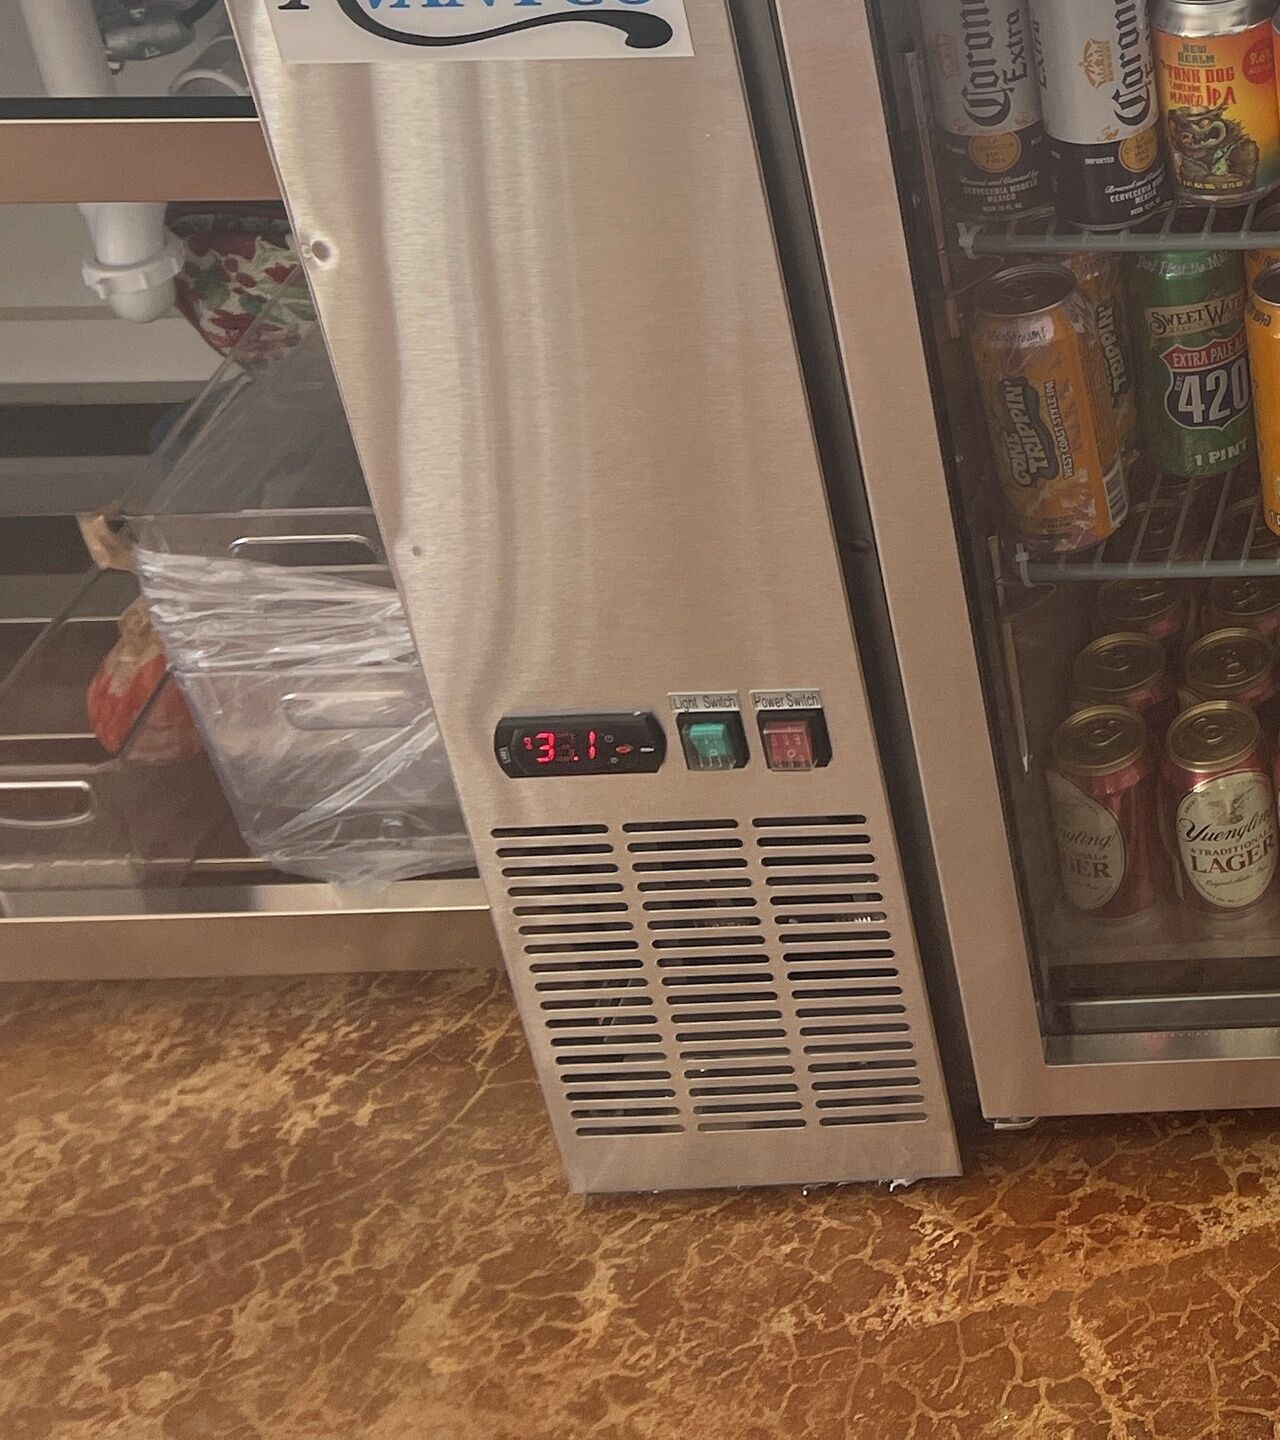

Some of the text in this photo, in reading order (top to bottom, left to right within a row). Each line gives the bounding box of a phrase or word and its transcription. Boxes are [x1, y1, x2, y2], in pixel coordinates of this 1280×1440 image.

[1002, 8, 1029, 90] Extra
[1205, 66, 1236, 83] DOG
[1206, 85, 1237, 107] IPA
[1173, 342, 1234, 368] EXTRA PALE
[1177, 357, 1250, 424] 420
[1003, 380, 1048, 486] GONE TRIPPIN'
[673, 695, 738, 714] Light Switch
[754, 693, 818, 708] Power Switch
[1191, 834, 1273, 874] LAGER
